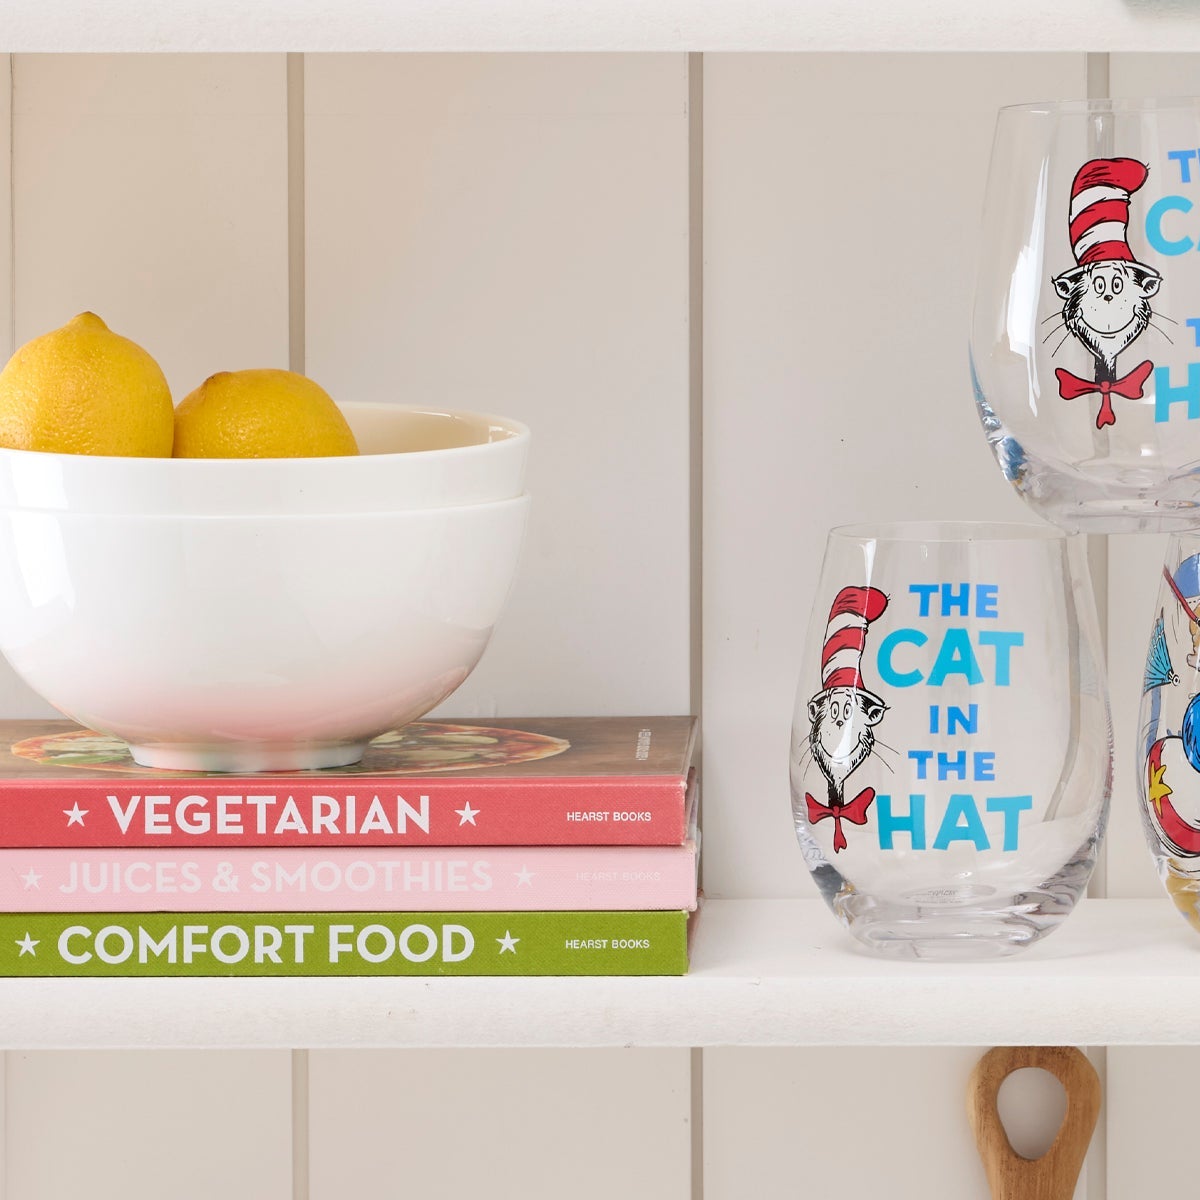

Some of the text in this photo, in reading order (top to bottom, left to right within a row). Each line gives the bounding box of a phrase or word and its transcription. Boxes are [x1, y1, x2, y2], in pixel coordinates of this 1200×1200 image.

[908, 583, 999, 618] THE
[876, 628, 1024, 688] CAT
[929, 704, 978, 735] IN
[907, 750, 995, 781] THE
[106, 795, 430, 835] VEGETARIAN
[566, 811, 652, 821] HEARST BOOKS
[875, 794, 1033, 852] HAT
[59, 860, 493, 894] JUICES & SMOOTHIES
[576, 872, 661, 881] HEARST BOOKS
[57, 924, 475, 965] COMFORT FOOD
[565, 939, 650, 949] HEARST BOOKS
